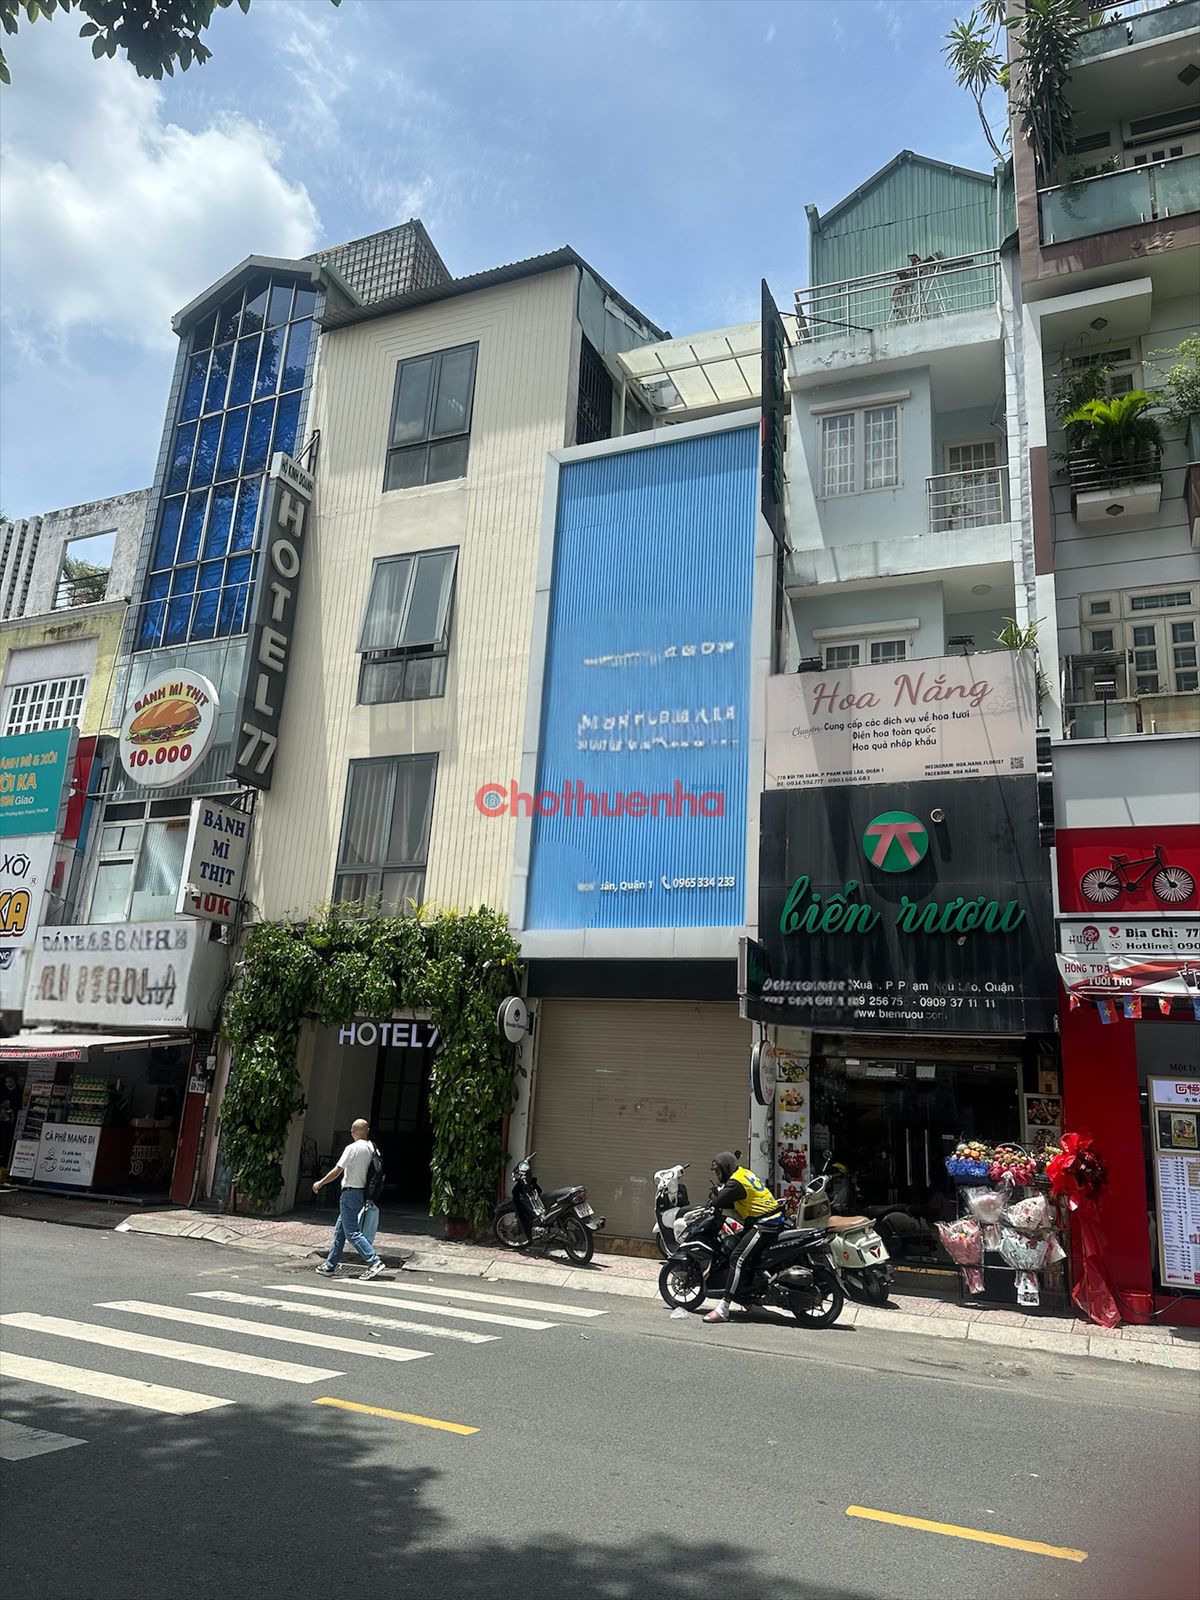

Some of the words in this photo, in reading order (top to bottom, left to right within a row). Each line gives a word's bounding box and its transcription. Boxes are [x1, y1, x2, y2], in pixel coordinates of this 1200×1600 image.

[253, 489, 305, 717] HOTEL
[134, 687, 167, 713] BÁNH
[169, 682, 183, 696] MÌ
[185, 684, 210, 707] THỊT
[812, 680, 881, 716] Hoa
[893, 671, 994, 709] Nắng
[824, 722, 845, 732] Cung
[847, 717, 863, 730] cấp
[865, 719, 880, 727] các
[883, 716, 902, 726] dịch
[918, 711, 930, 722] về
[932, 713, 949, 721] hoa
[952, 709, 970, 719] tươi
[852, 730, 871, 740] Điện
[873, 729, 889, 738] hoa
[892, 727, 912, 736] toàn
[914, 723, 937, 735] quốc
[129, 743, 192, 767] 10.000
[237, 722, 278, 774] 77
[852, 743, 869, 751] Hoa
[15, 796, 35, 806] Giao
[203, 809, 246, 838] BÁNH
[212, 838, 231, 860] MÌ
[200, 861, 235, 888] THỊT
[620, 880, 645, 892] Quận
[672, 877, 696, 889] 0965
[697, 877, 716, 888] 334
[718, 876, 736, 888] 233
[779, 875, 882, 934] biển
[895, 896, 1025, 944] rượu
[1126, 942, 1173, 950] Hotline:
[898, 981, 928, 992] Pạm
[985, 982, 1014, 993] Quận
[869, 996, 889, 1006] 256
[919, 997, 946, 1007] 0909
[950, 998, 964, 1007] 37
[968, 998, 978, 1008] 11
[985, 999, 996, 1008] 11
[338, 1021, 423, 1048] HOTEL
[45, 1129, 54, 1141] CÀ
[54, 1131, 67, 1142] PHÊ
[67, 1134, 88, 1144] MANG
[88, 1136, 96, 1144] ĐI
